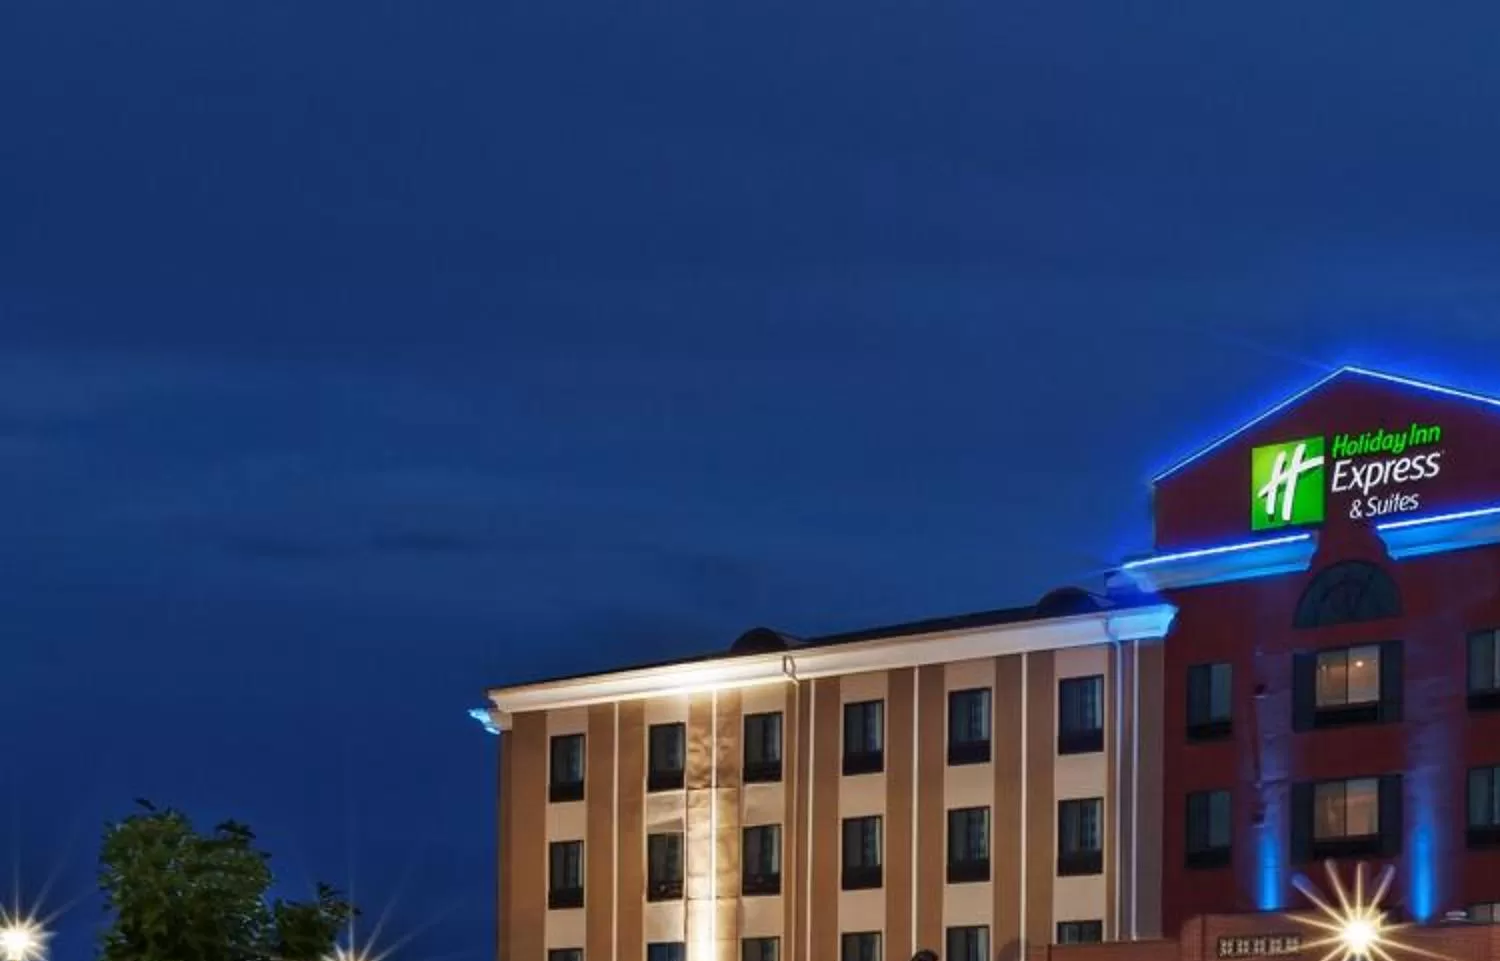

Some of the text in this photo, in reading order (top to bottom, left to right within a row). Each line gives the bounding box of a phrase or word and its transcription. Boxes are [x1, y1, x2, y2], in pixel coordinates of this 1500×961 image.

[1332, 423, 1441, 458] Holiday Inn
[1331, 452, 1441, 495] Express
[1349, 492, 1420, 519] & Suites
